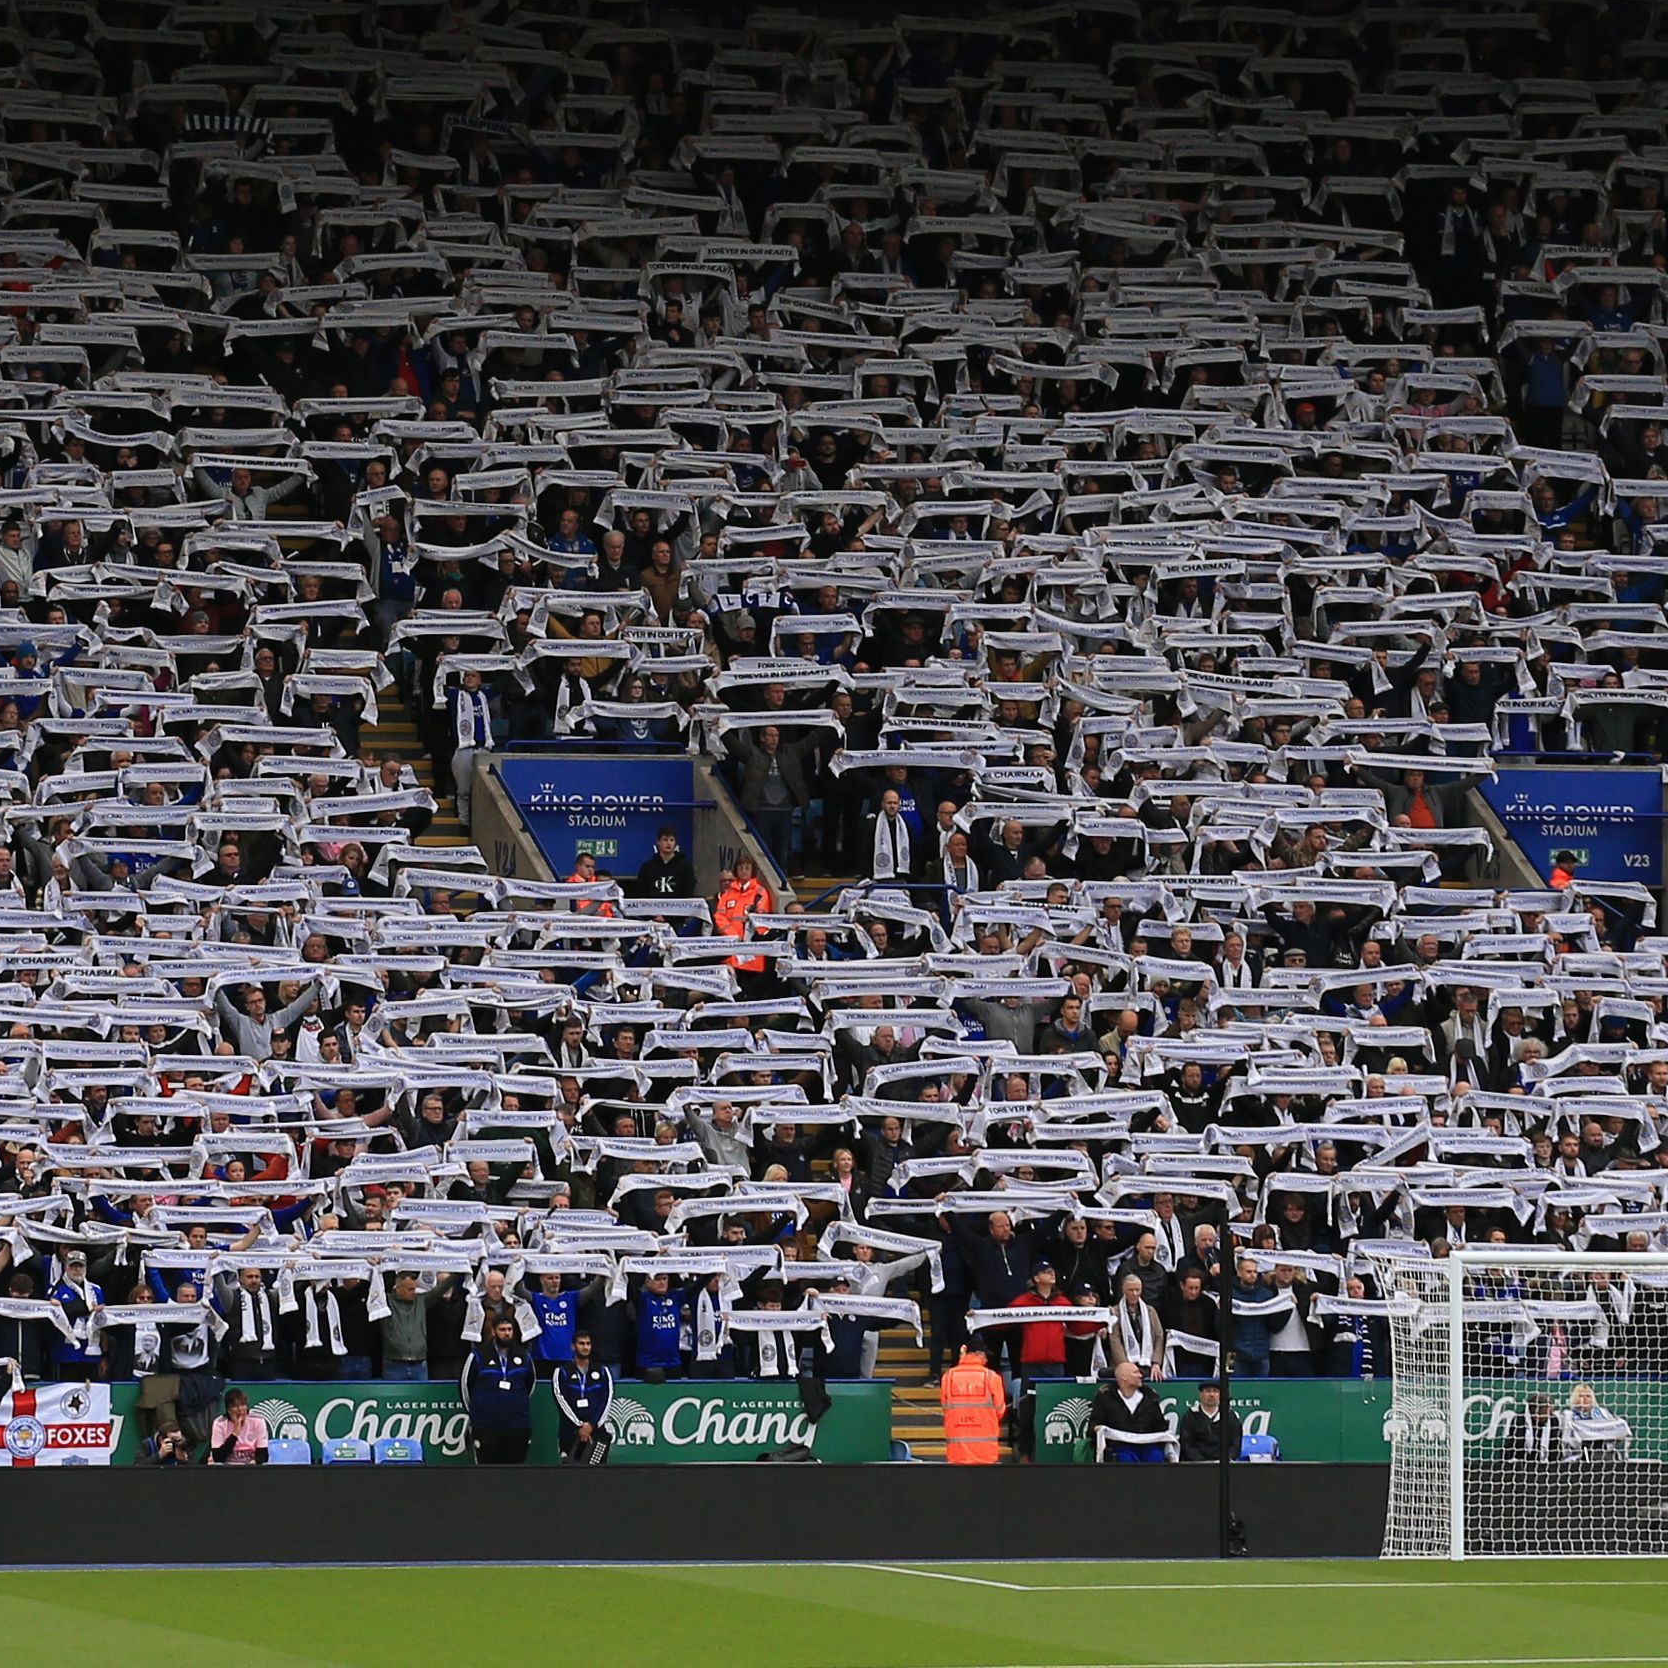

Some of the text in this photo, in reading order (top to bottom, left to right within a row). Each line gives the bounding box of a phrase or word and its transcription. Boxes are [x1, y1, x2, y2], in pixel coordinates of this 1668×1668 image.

[708, 248, 739, 256] FOREVER
[750, 249, 763, 257] OUR
[764, 249, 792, 257] HEARTS
[691, 263, 704, 271] OUR
[264, 460, 299, 469] HEARTS
[1167, 561, 1232, 573] MR CHAIRMAN
[647, 631, 673, 639] IN OUR
[734, 669, 829, 681] FOREVER IN OUR HEARTS
[1222, 678, 1237, 686] OUR
[1239, 679, 1274, 689] HEARTS
[994, 771, 1043, 779] CHAIRMAN
[531, 795, 663, 812] KING POWER
[1505, 804, 1635, 823] KING POWER
[568, 815, 626, 827] STADIUM
[1541, 825, 1598, 837] STADIUM
[1623, 854, 1651, 867] V23
[6, 957, 74, 966] MR CHAIRMAN
[576, 955, 605, 963] POSSIBLE
[1132, 1095, 1160, 1104] POSSIBLE
[859, 1101, 881, 1109] VICHAI
[989, 1106, 1025, 1114] FOREVER
[1054, 1156, 1084, 1164] POSSIBLE
[760, 1198, 790, 1207] POSSIBLE
[653, 1314, 676, 1322] KING
[733, 1401, 773, 1409] LAGER
[314, 1397, 470, 1456] Chang
[47, 1427, 107, 1444] FOXES
